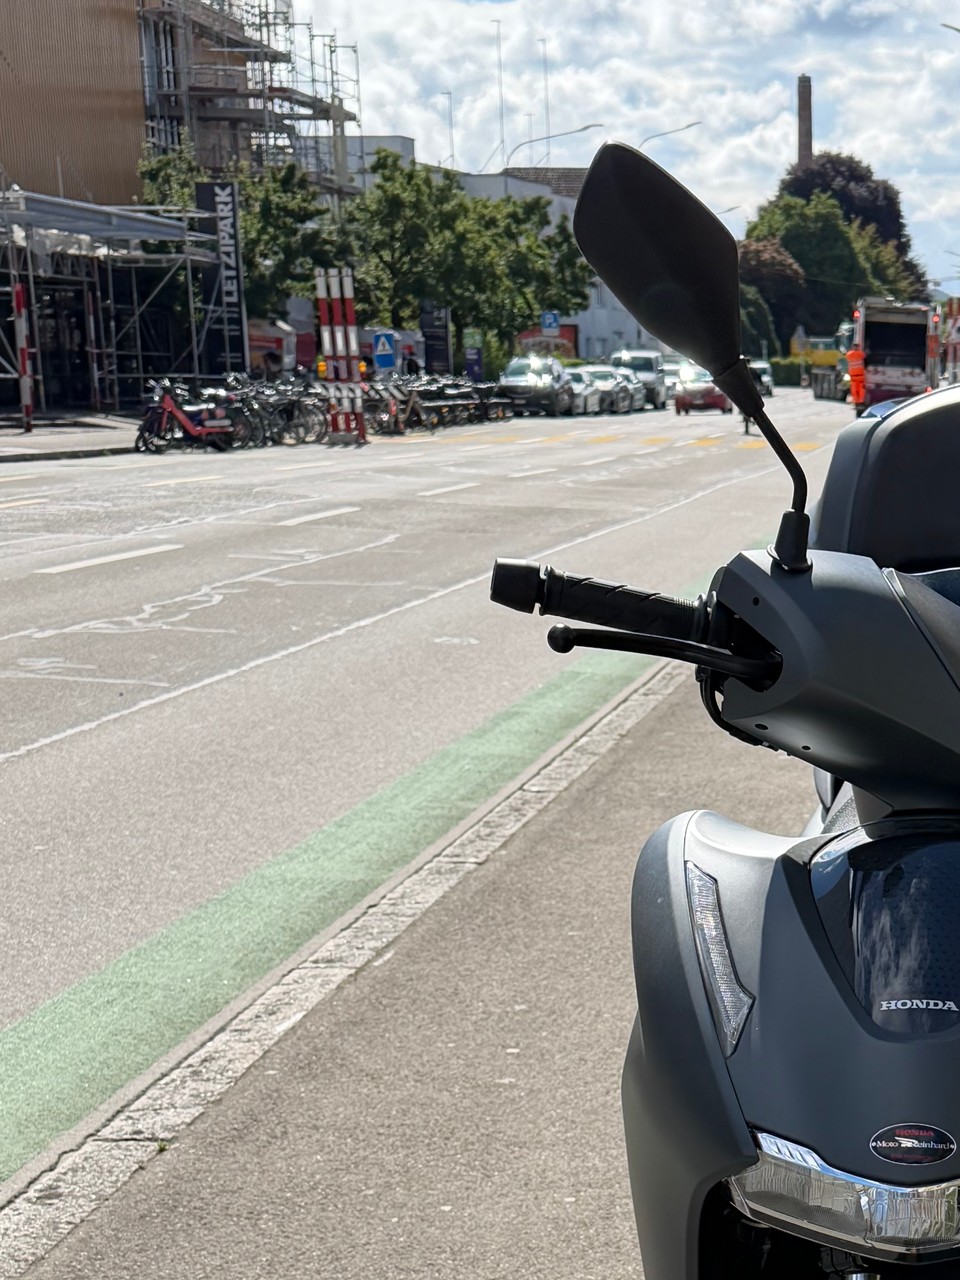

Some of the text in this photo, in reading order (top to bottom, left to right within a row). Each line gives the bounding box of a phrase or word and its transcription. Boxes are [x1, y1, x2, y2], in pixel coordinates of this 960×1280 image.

[214, 185, 238, 303] LETZIPARK
[880, 999, 959, 1011] HONDA
[895, 1129, 936, 1137] HONDA
[876, 1137, 950, 1150] Moto Reinhard
